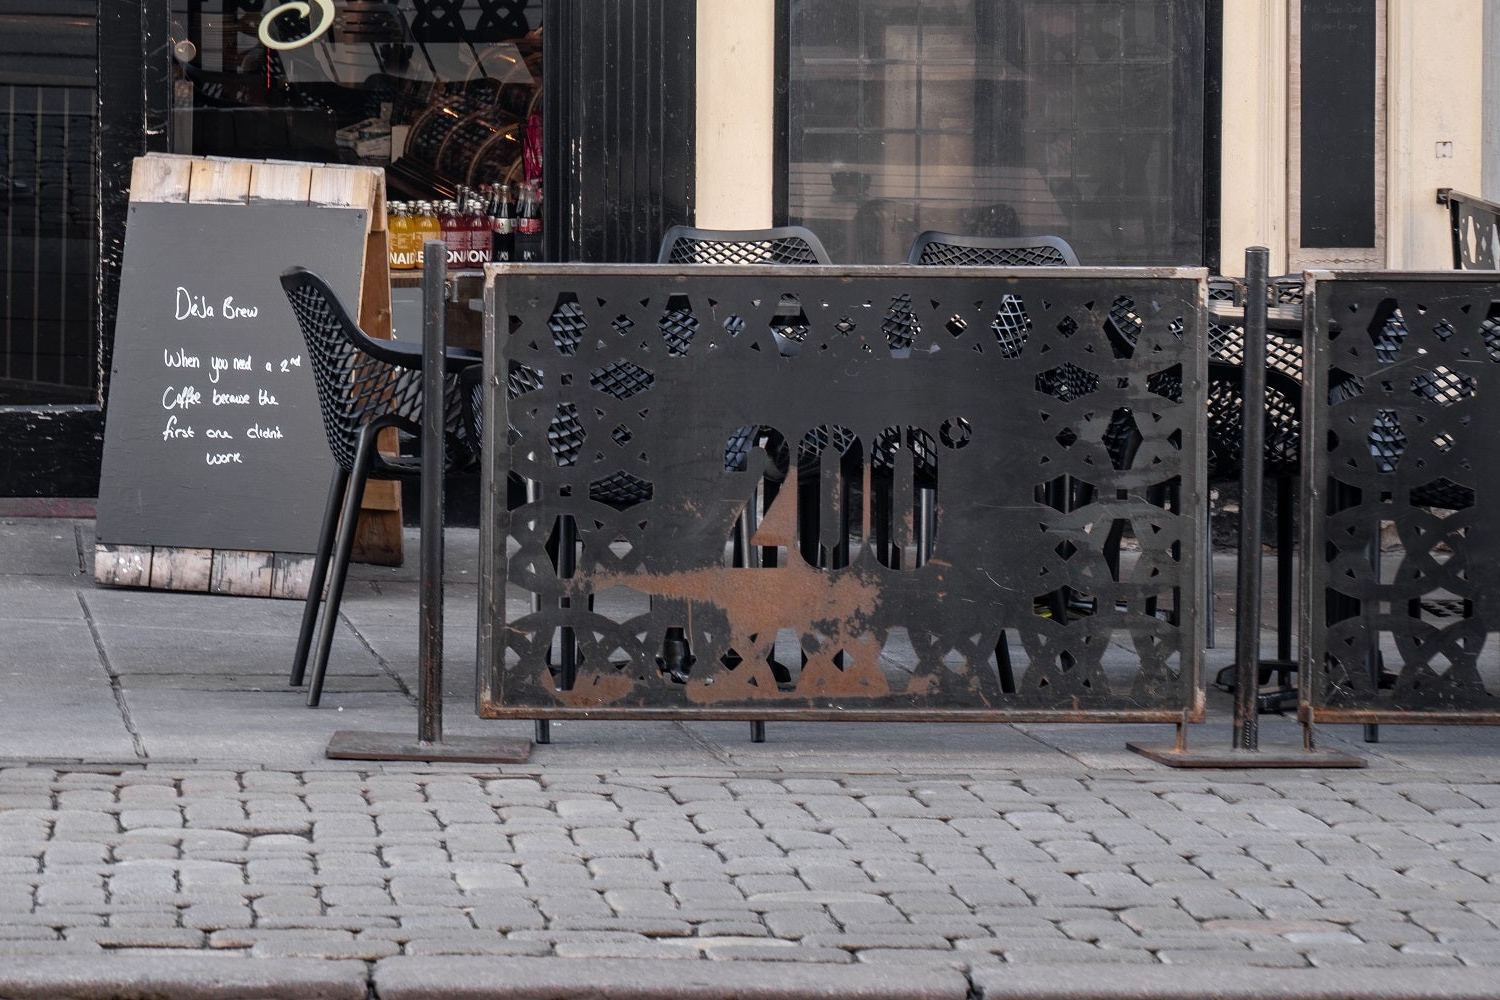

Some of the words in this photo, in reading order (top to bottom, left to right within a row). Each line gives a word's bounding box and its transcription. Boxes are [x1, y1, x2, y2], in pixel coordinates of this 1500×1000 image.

[222, 296, 258, 319] Brew
[164, 347, 200, 369] When
[208, 356, 228, 383] you
[233, 355, 252, 371] need
[265, 361, 272, 372] a
[280, 355, 301, 373] 2nd
[162, 386, 202, 410] Coffee
[212, 388, 251, 406] because
[258, 388, 279, 406] the
[162, 415, 195, 441] first
[206, 429, 233, 439] one
[206, 452, 243, 466] work
